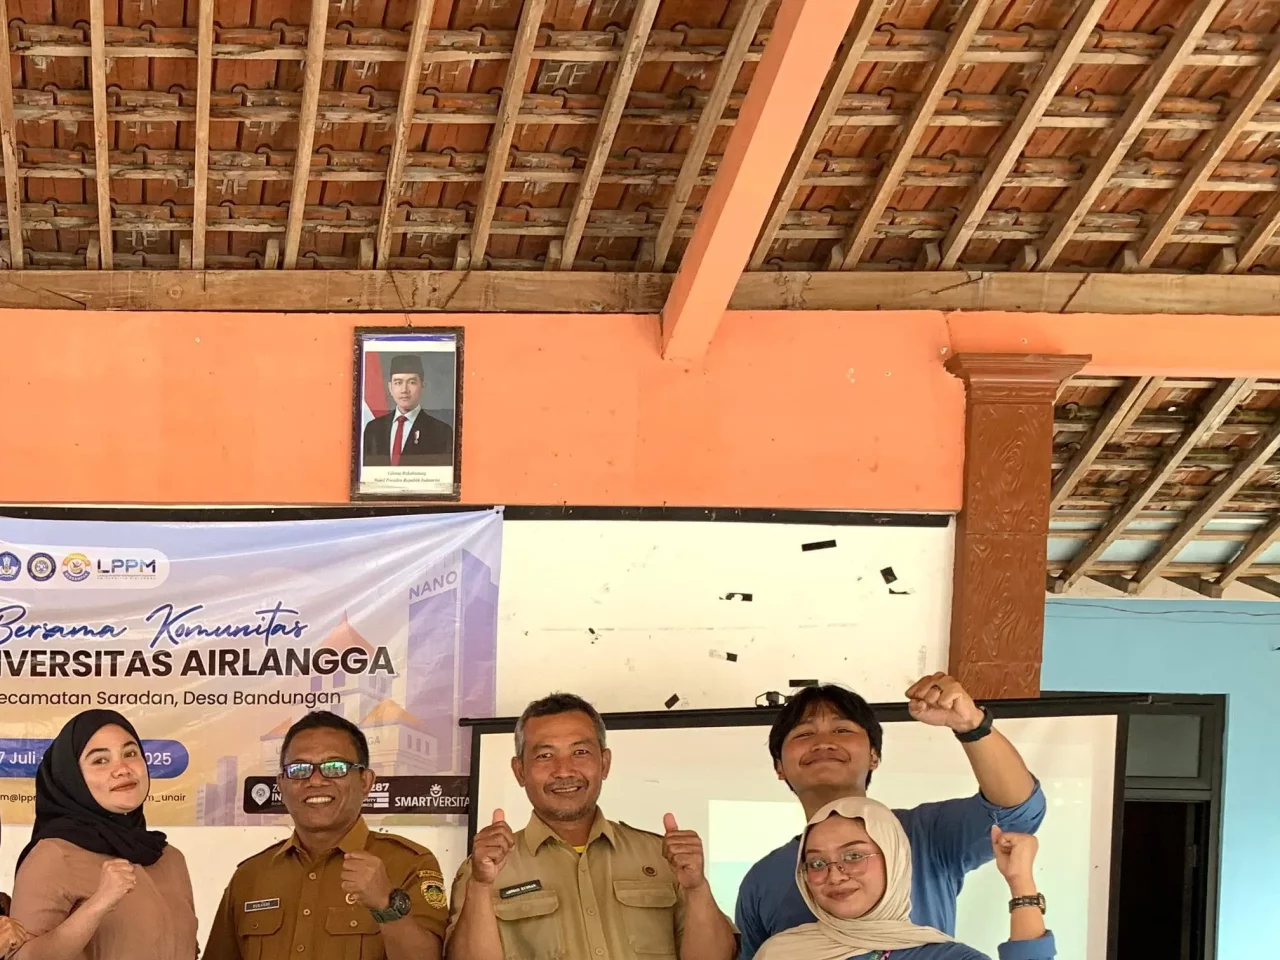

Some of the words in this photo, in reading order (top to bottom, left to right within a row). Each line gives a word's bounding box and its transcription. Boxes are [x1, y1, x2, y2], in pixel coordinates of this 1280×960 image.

[97, 558, 156, 574] LPPM
[409, 571, 458, 600] NANO
[145, 600, 308, 648] Komunitas
[180, 645, 395, 677] AIRLANGGA
[97, 690, 178, 707] Saradan,
[183, 691, 229, 706] Desa
[234, 689, 341, 708] Bandungan
[9, 751, 37, 765] Juli
[146, 752, 172, 766] 025
